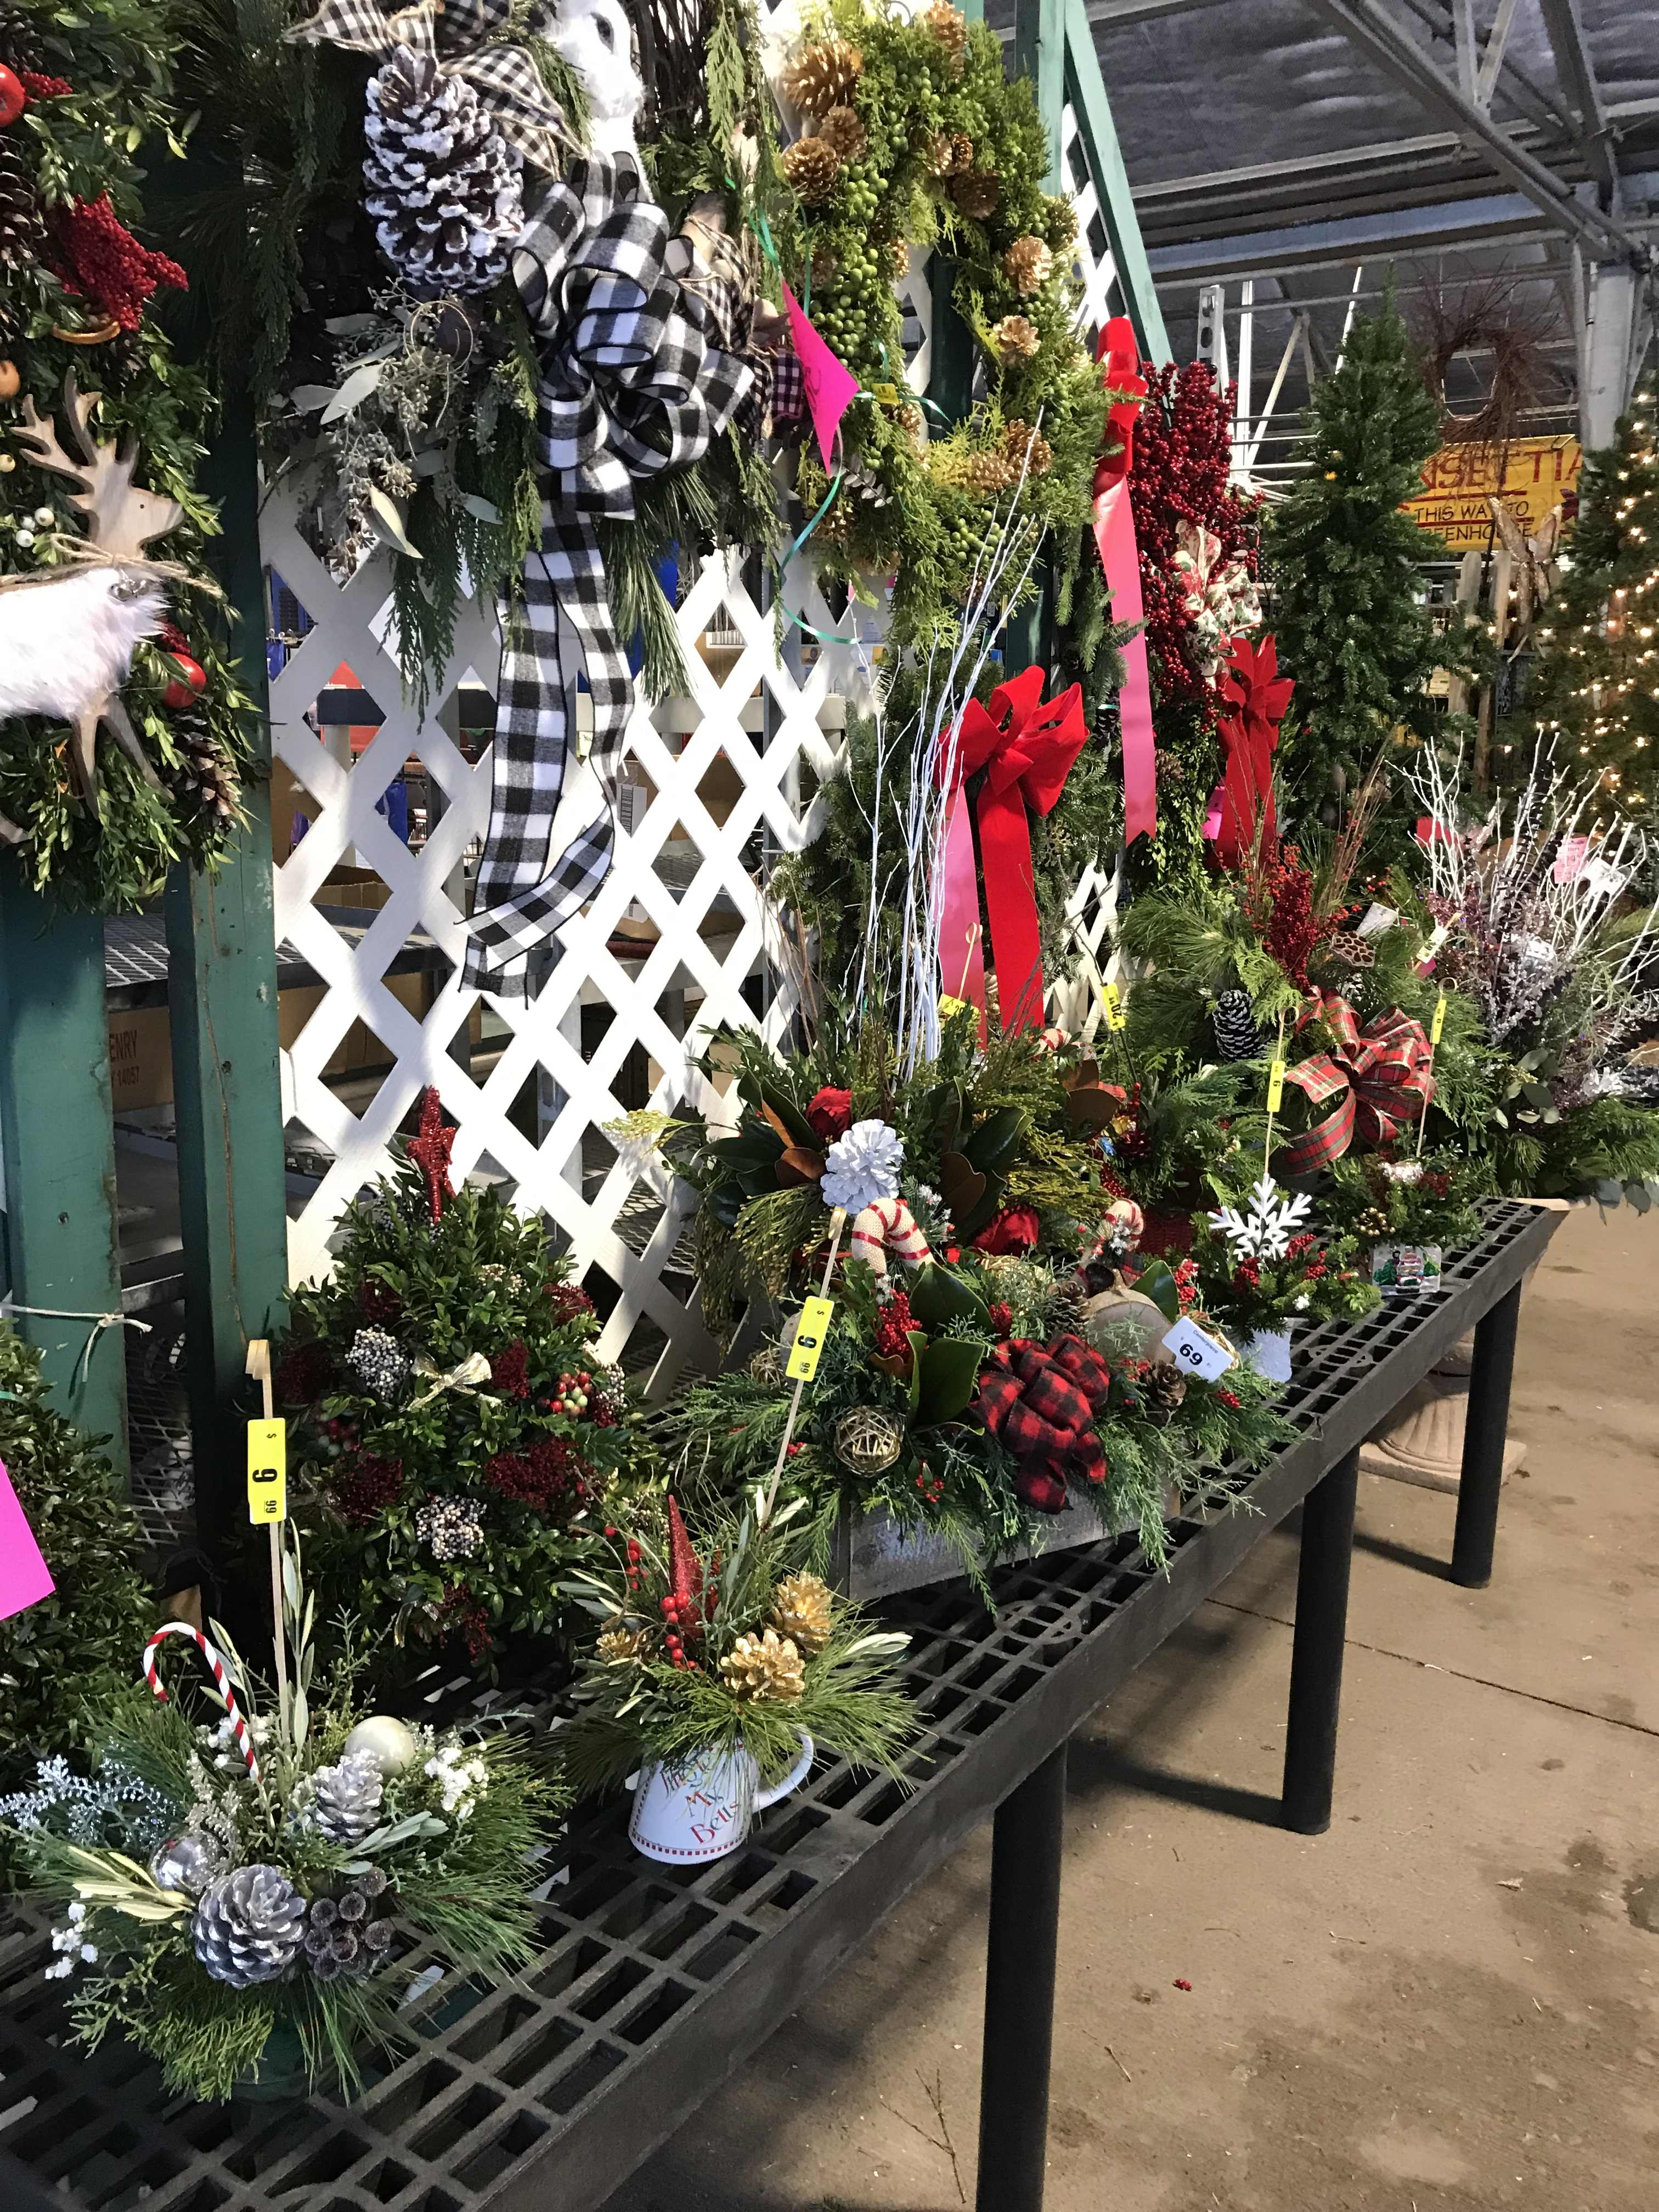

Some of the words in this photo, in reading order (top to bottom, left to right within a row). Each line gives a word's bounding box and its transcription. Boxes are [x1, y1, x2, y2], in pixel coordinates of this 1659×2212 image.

[1414, 506, 1454, 522] THIS
[1461, 503, 1492, 519] WA
[1507, 500, 1529, 516] TO
[1111, 1003, 1122, 1019] 20
[798, 1335, 817, 1349] 9
[1180, 1344, 1203, 1365] 69
[252, 1468, 278, 1482] 9
[264, 1500, 277, 1514] 99
[690, 1801, 740, 1844] Bells
